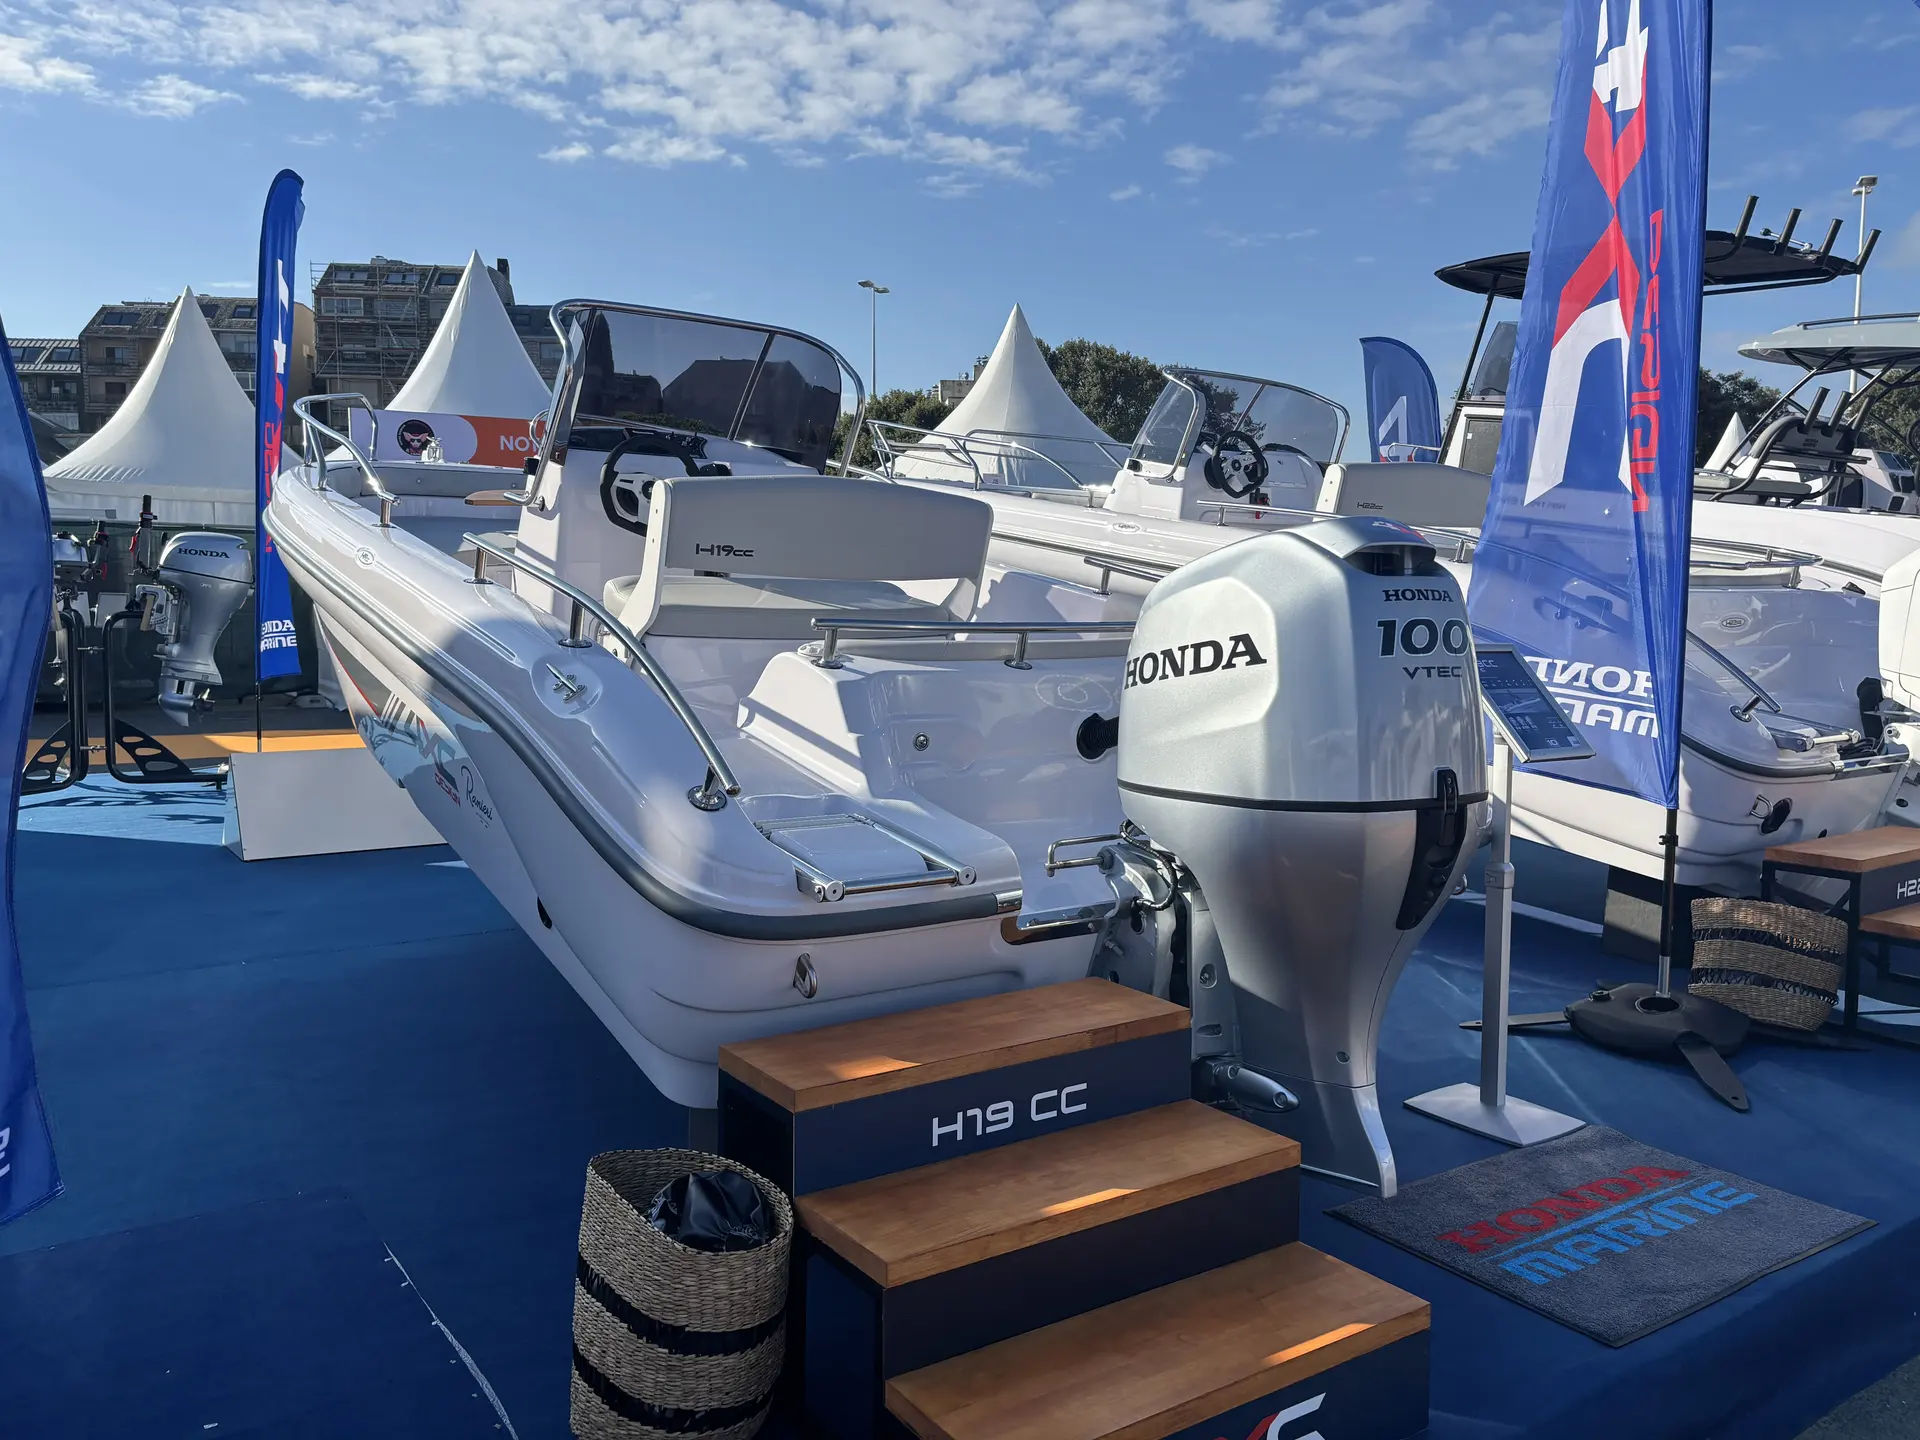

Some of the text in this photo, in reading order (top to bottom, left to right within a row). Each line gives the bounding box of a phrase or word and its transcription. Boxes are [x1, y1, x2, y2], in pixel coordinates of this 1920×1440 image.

[178, 547, 230, 559] HONDA
[1382, 589, 1454, 602] HONDA
[1124, 633, 1267, 690] HONDA
[1377, 617, 1470, 658] 100
[1402, 666, 1463, 680] VTEC
[460, 764, 494, 821] Ranieri
[932, 1082, 1088, 1147] H19 CC
[1435, 1166, 1691, 1254] HONDA
[1499, 1180, 1758, 1286] MARINE
